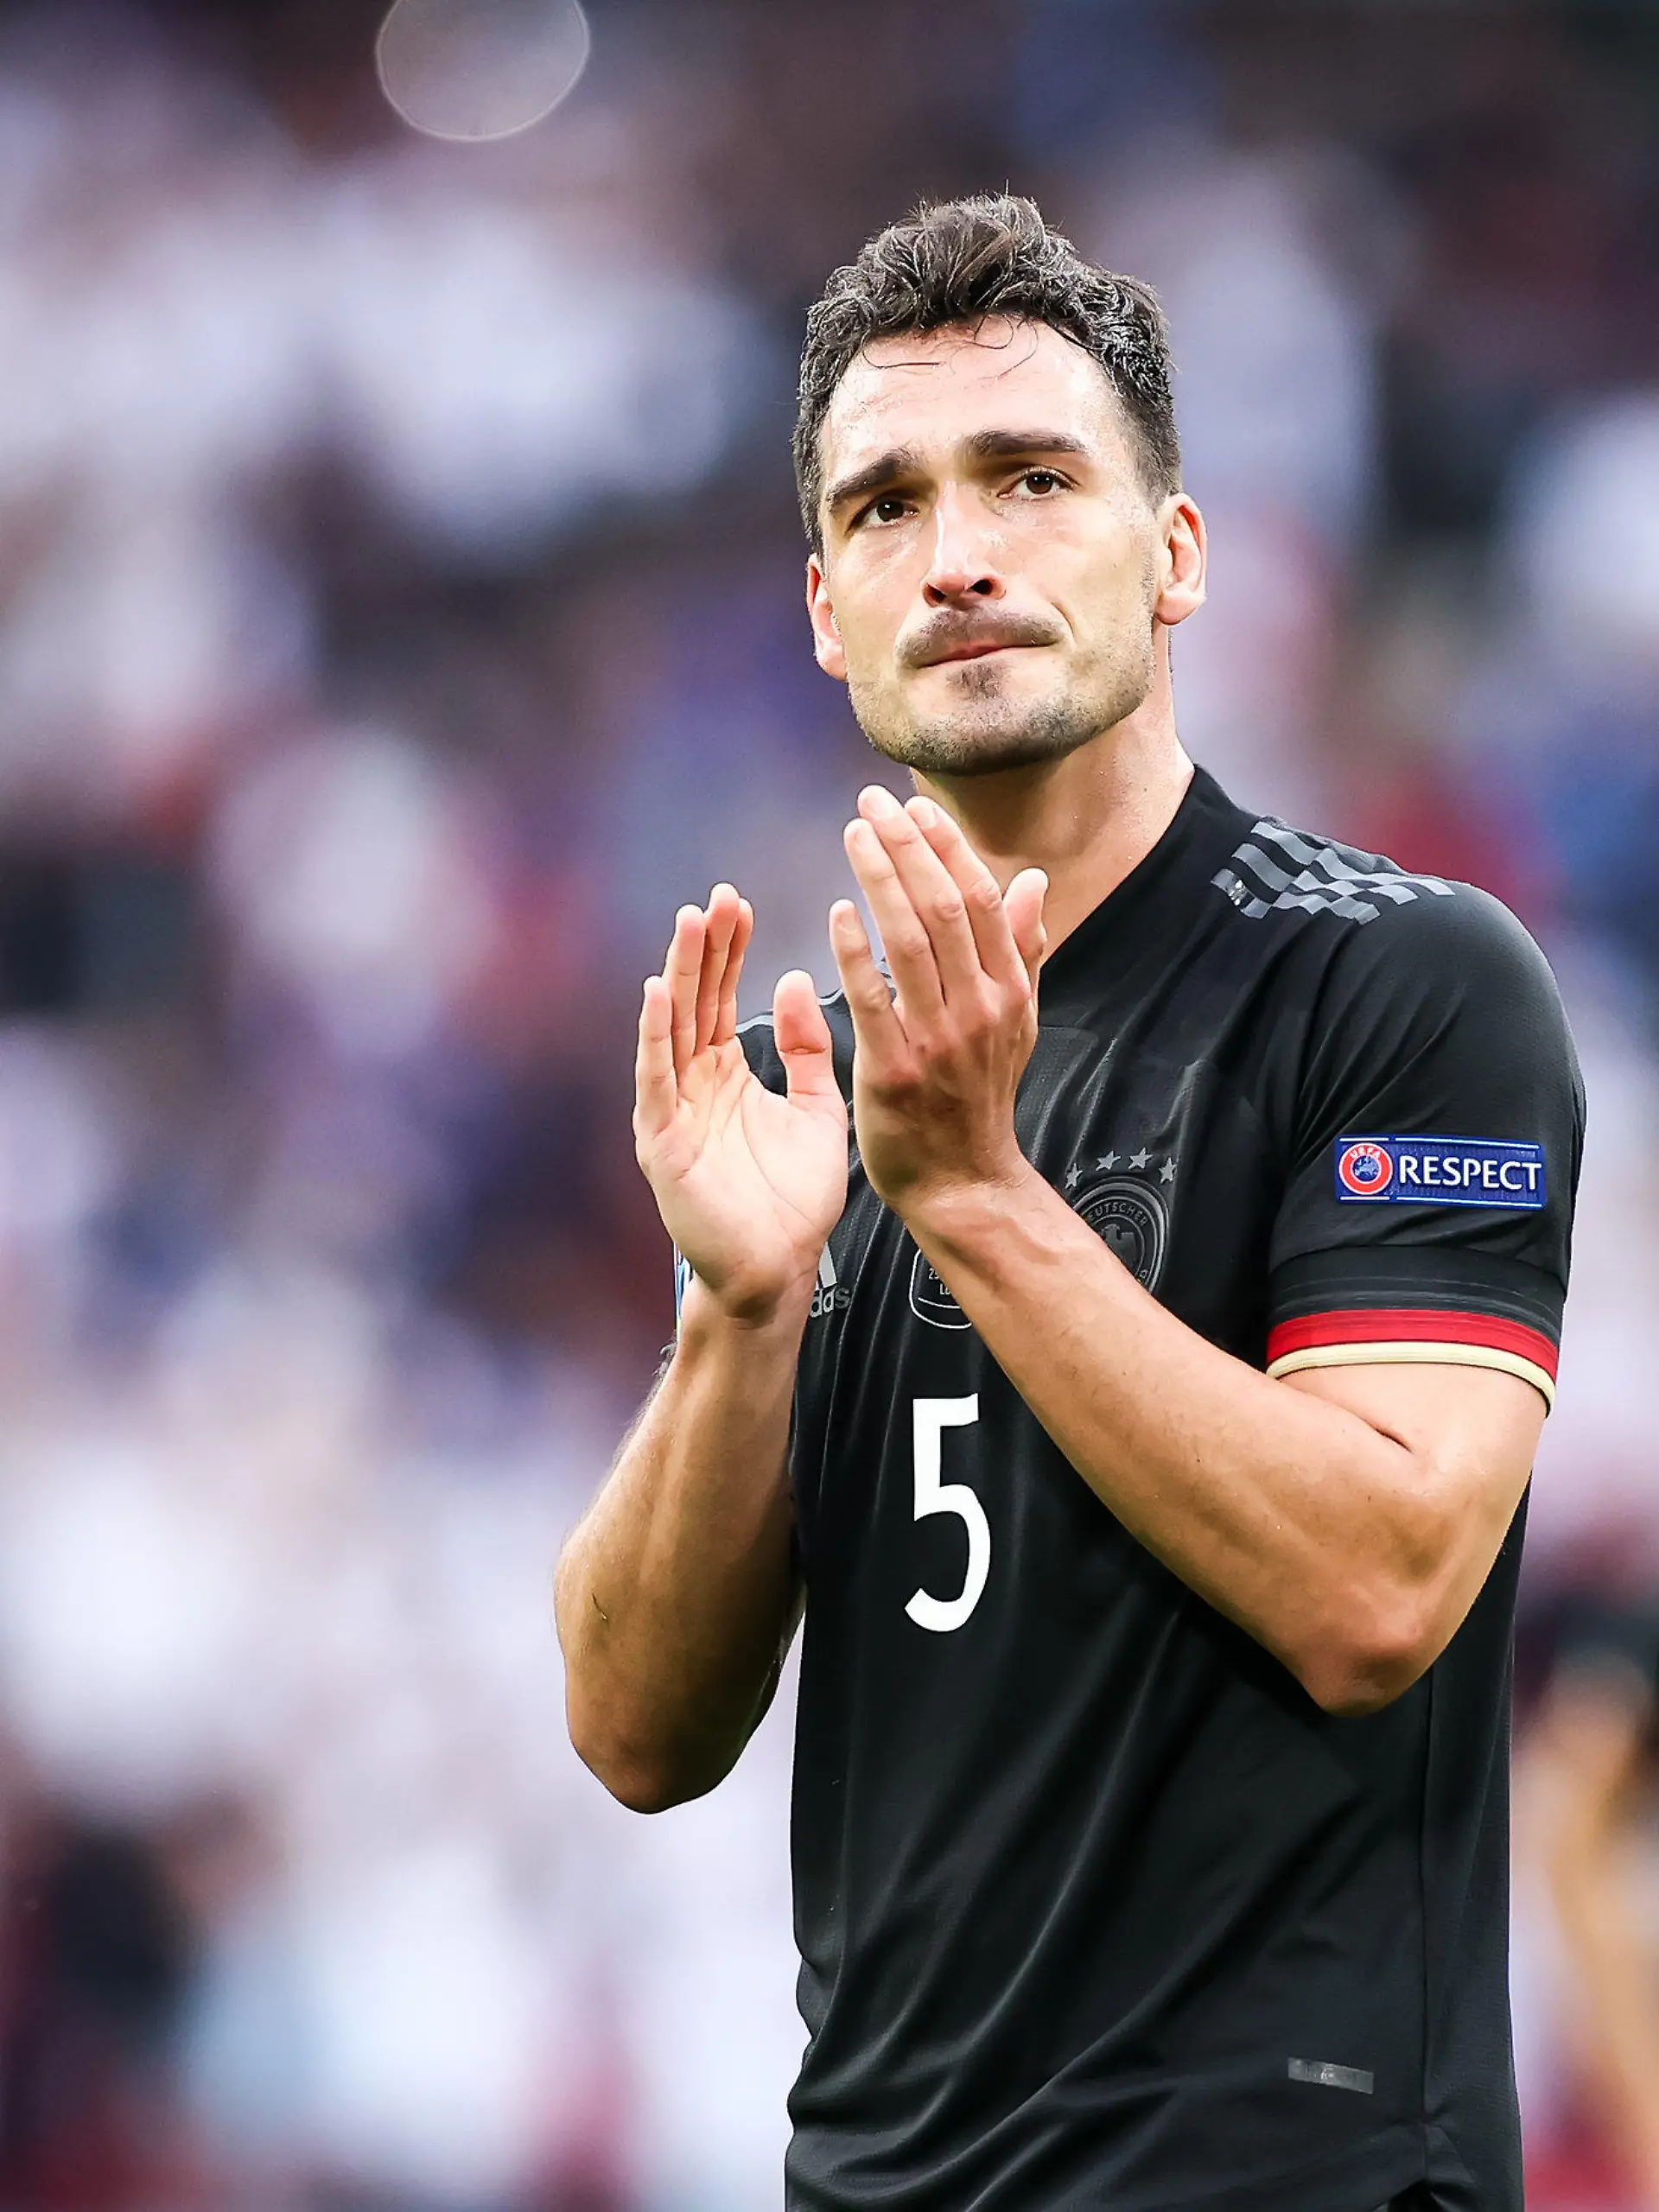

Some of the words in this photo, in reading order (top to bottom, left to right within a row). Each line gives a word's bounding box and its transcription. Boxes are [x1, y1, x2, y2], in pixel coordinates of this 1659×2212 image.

[1349, 1146, 1382, 1160] UEFA
[1398, 1154, 1542, 1192] RESPECT
[1087, 1201, 1149, 1227] EUTSCHER
[809, 1285, 851, 1319] das
[905, 1392, 991, 1632] 5
